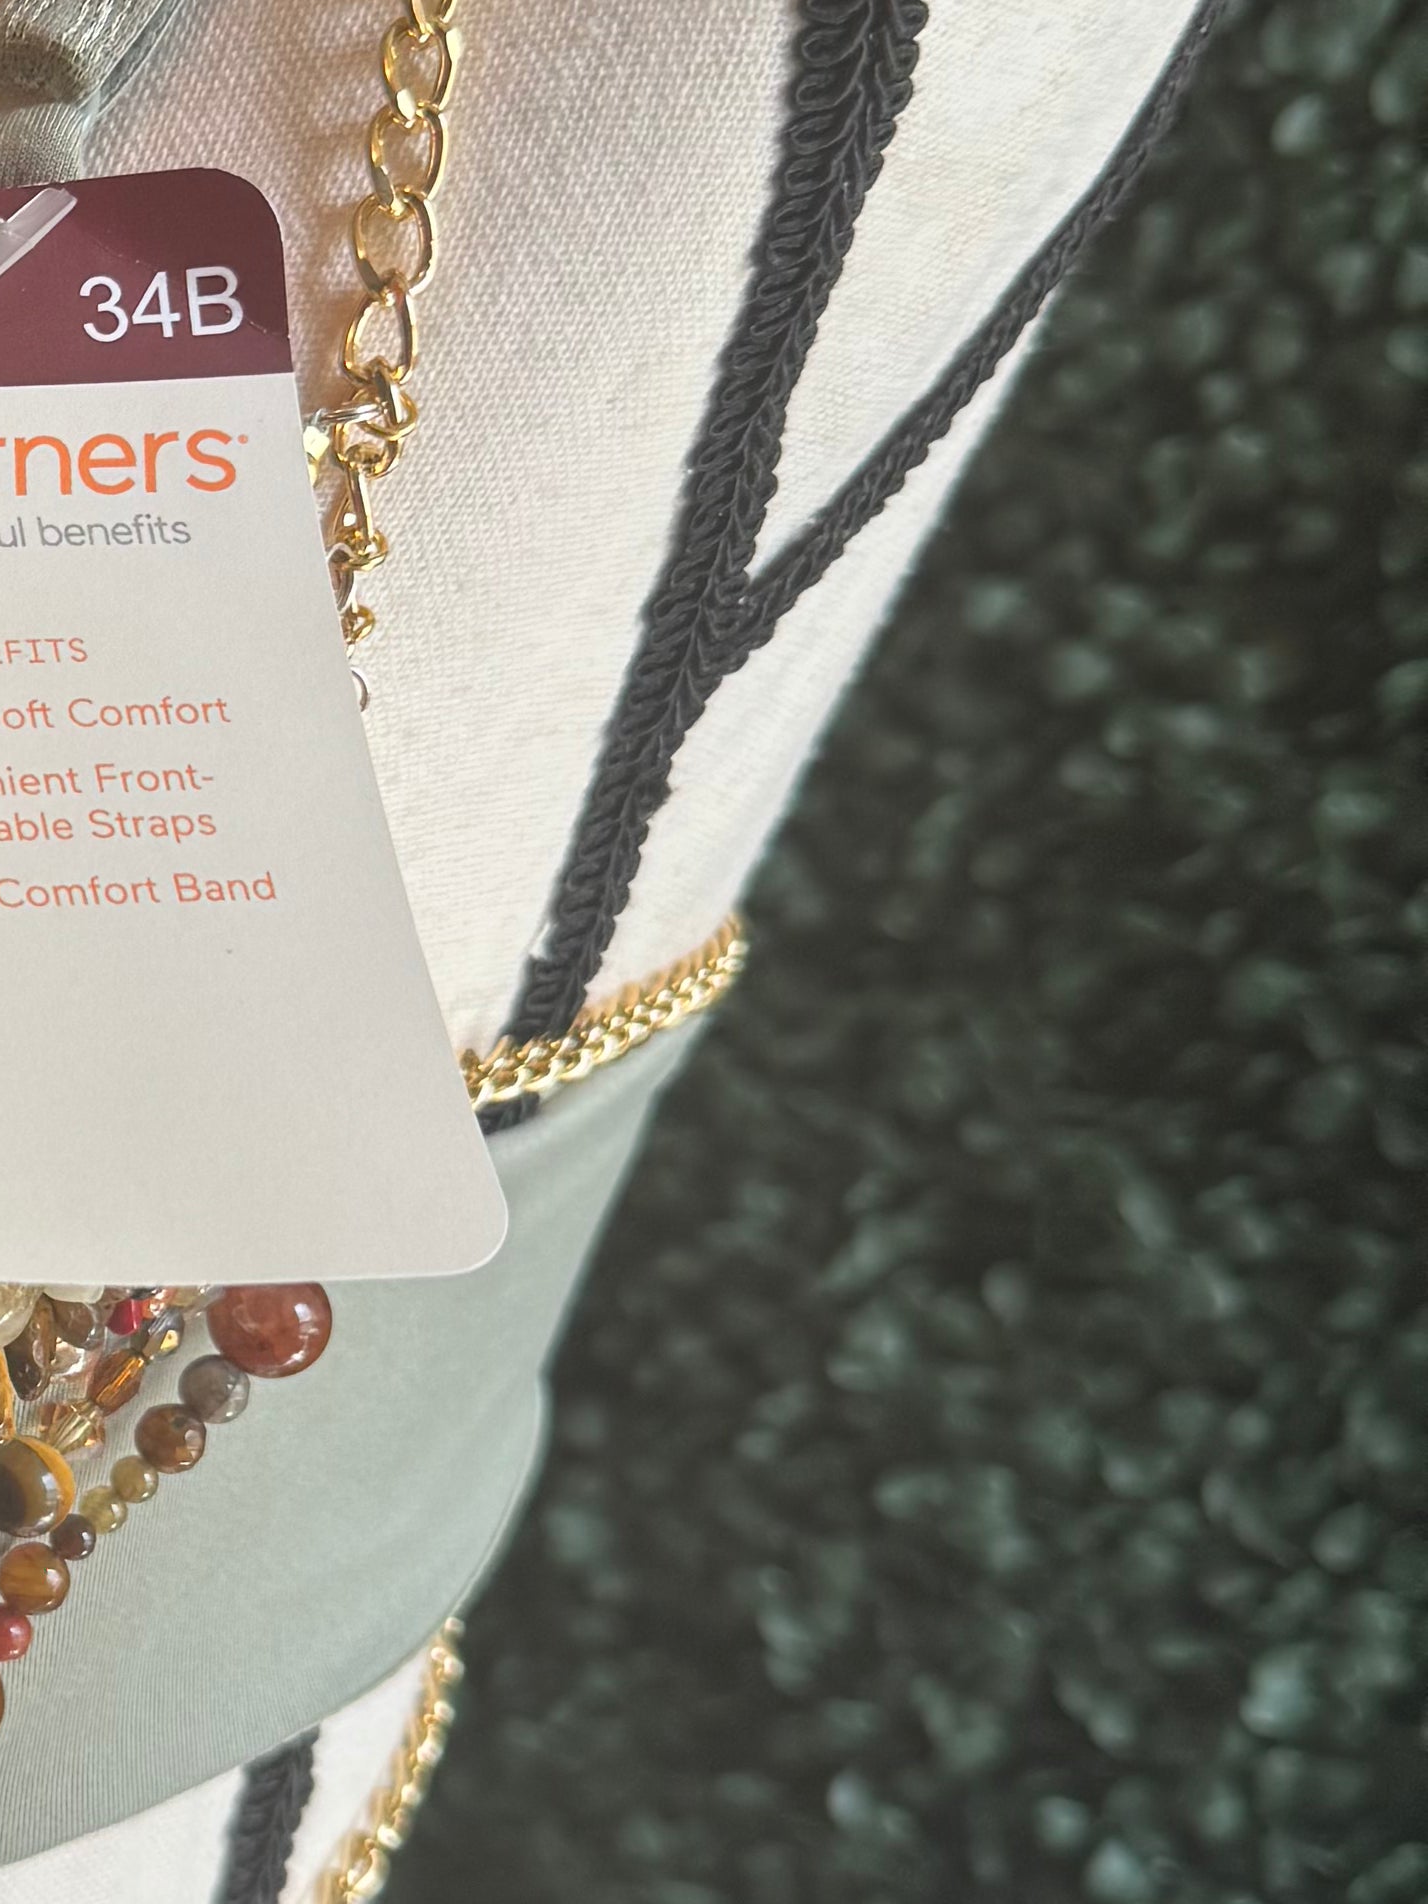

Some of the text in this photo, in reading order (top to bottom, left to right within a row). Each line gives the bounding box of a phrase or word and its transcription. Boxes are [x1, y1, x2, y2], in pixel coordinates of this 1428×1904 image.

[79, 266, 243, 343] 34B
[37, 514, 191, 546] benefits
[68, 696, 231, 727] Comfort
[95, 763, 213, 792] Front-
[89, 809, 216, 843] Straps
[174, 871, 276, 902] Band
